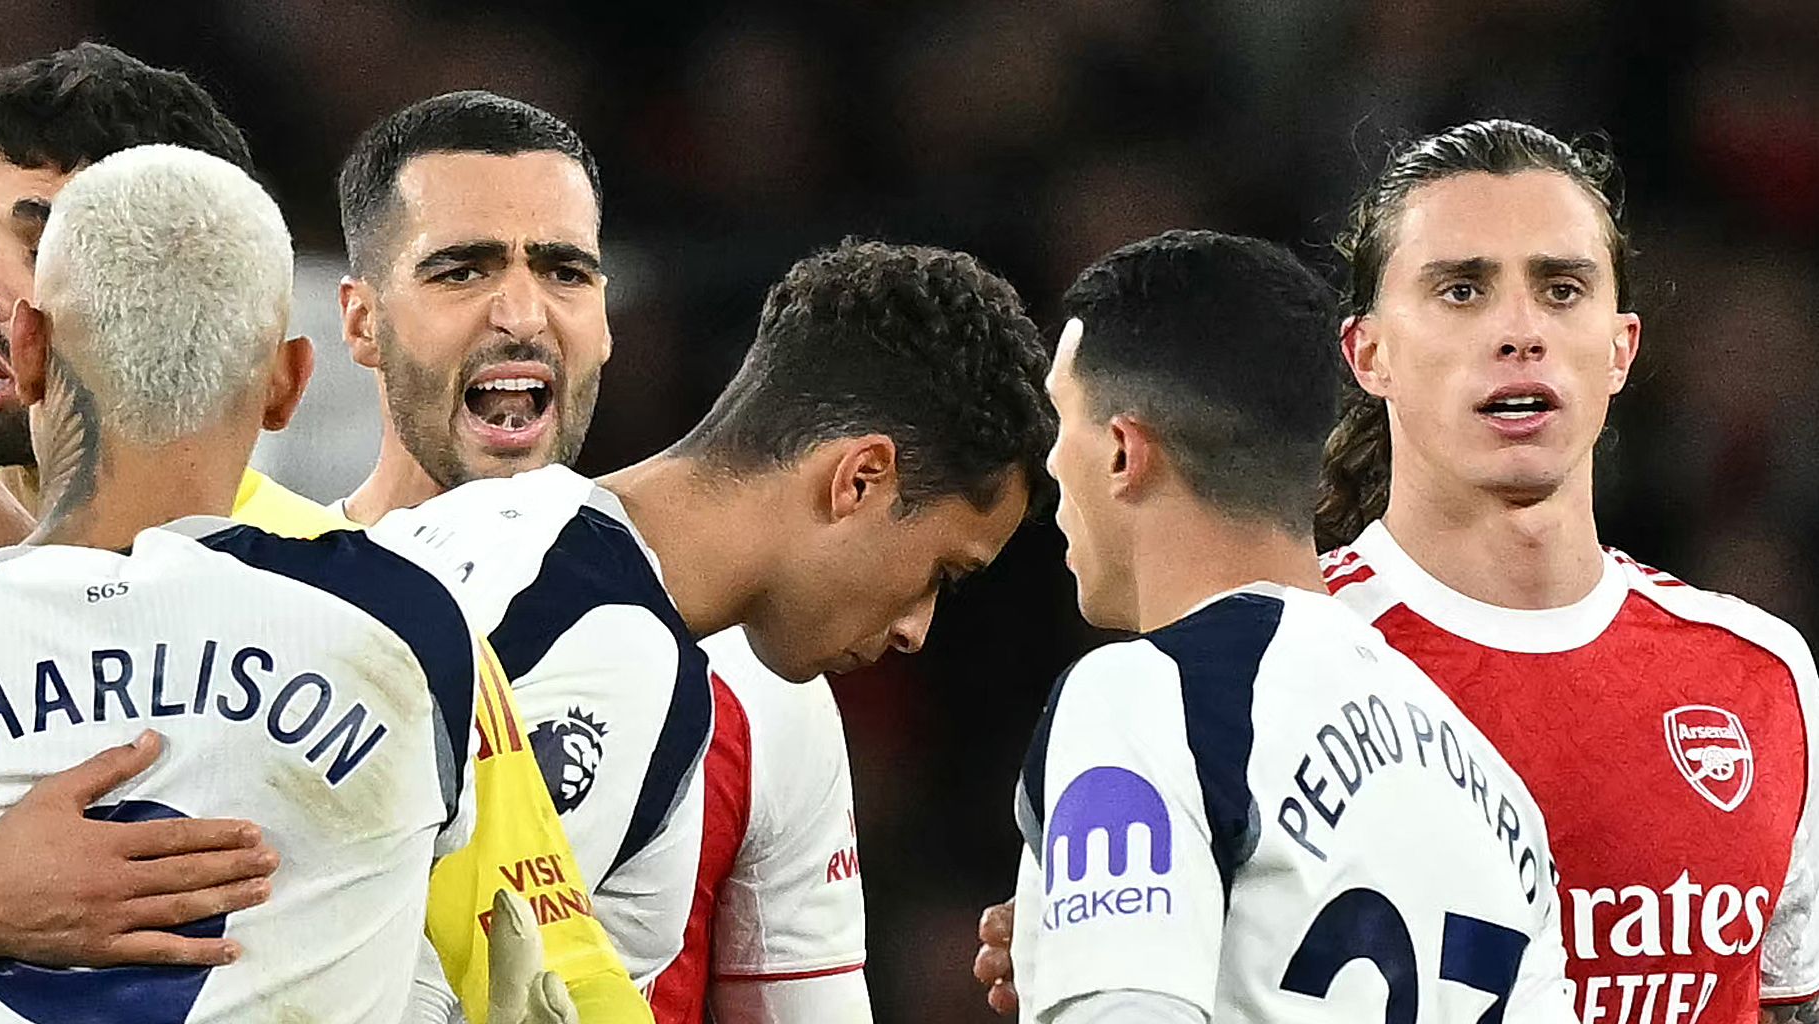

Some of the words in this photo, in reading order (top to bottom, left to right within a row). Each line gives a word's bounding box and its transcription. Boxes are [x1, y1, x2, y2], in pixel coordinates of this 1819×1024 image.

[86, 582, 131, 603] 865
[1679, 723, 1738, 740] Arsenal
[1277, 694, 1403, 862] PEDRO
[1404, 701, 1538, 905] PORRO
[1568, 868, 1770, 960] rates
